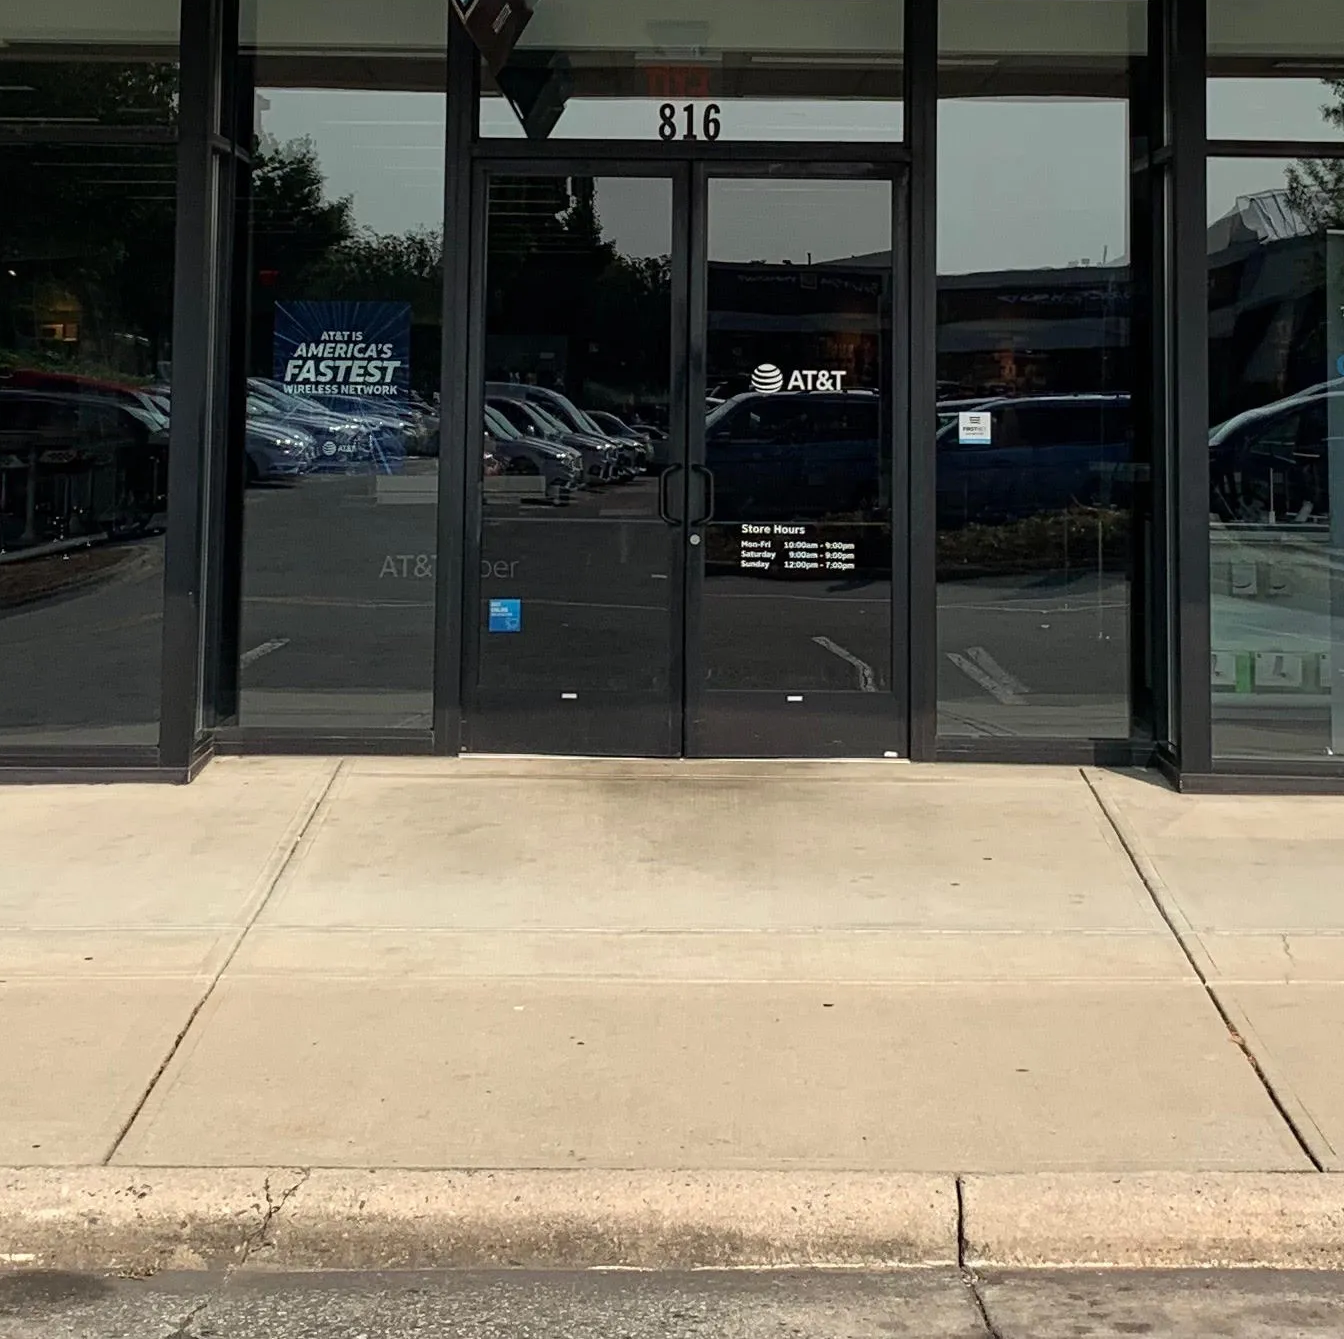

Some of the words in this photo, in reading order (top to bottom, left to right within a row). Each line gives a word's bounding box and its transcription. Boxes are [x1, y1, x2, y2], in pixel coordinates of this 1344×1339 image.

[659, 103, 720, 140] 816
[320, 331, 350, 340] AT&T
[352, 331, 363, 341] IS
[293, 342, 393, 358] AMERICA'S
[284, 359, 401, 382] FASTEST
[787, 369, 847, 391] AT&T
[283, 383, 338, 394] WIRELESS
[340, 384, 398, 395] NETWORK
[741, 523, 771, 534] Store
[773, 524, 805, 535] Hours
[740, 540, 771, 549] Mon-Fri
[783, 541, 818, 549] 10:00am
[824, 542, 855, 551] 9:00pm
[740, 550, 776, 560] Saturday
[788, 551, 818, 559] 9:00am
[824, 552, 855, 561] 9:00pm
[379, 554, 437, 578] AT&
[740, 560, 770, 569] Sunday
[783, 561, 818, 570] 12:00pm
[825, 562, 855, 571] 7:00pm
